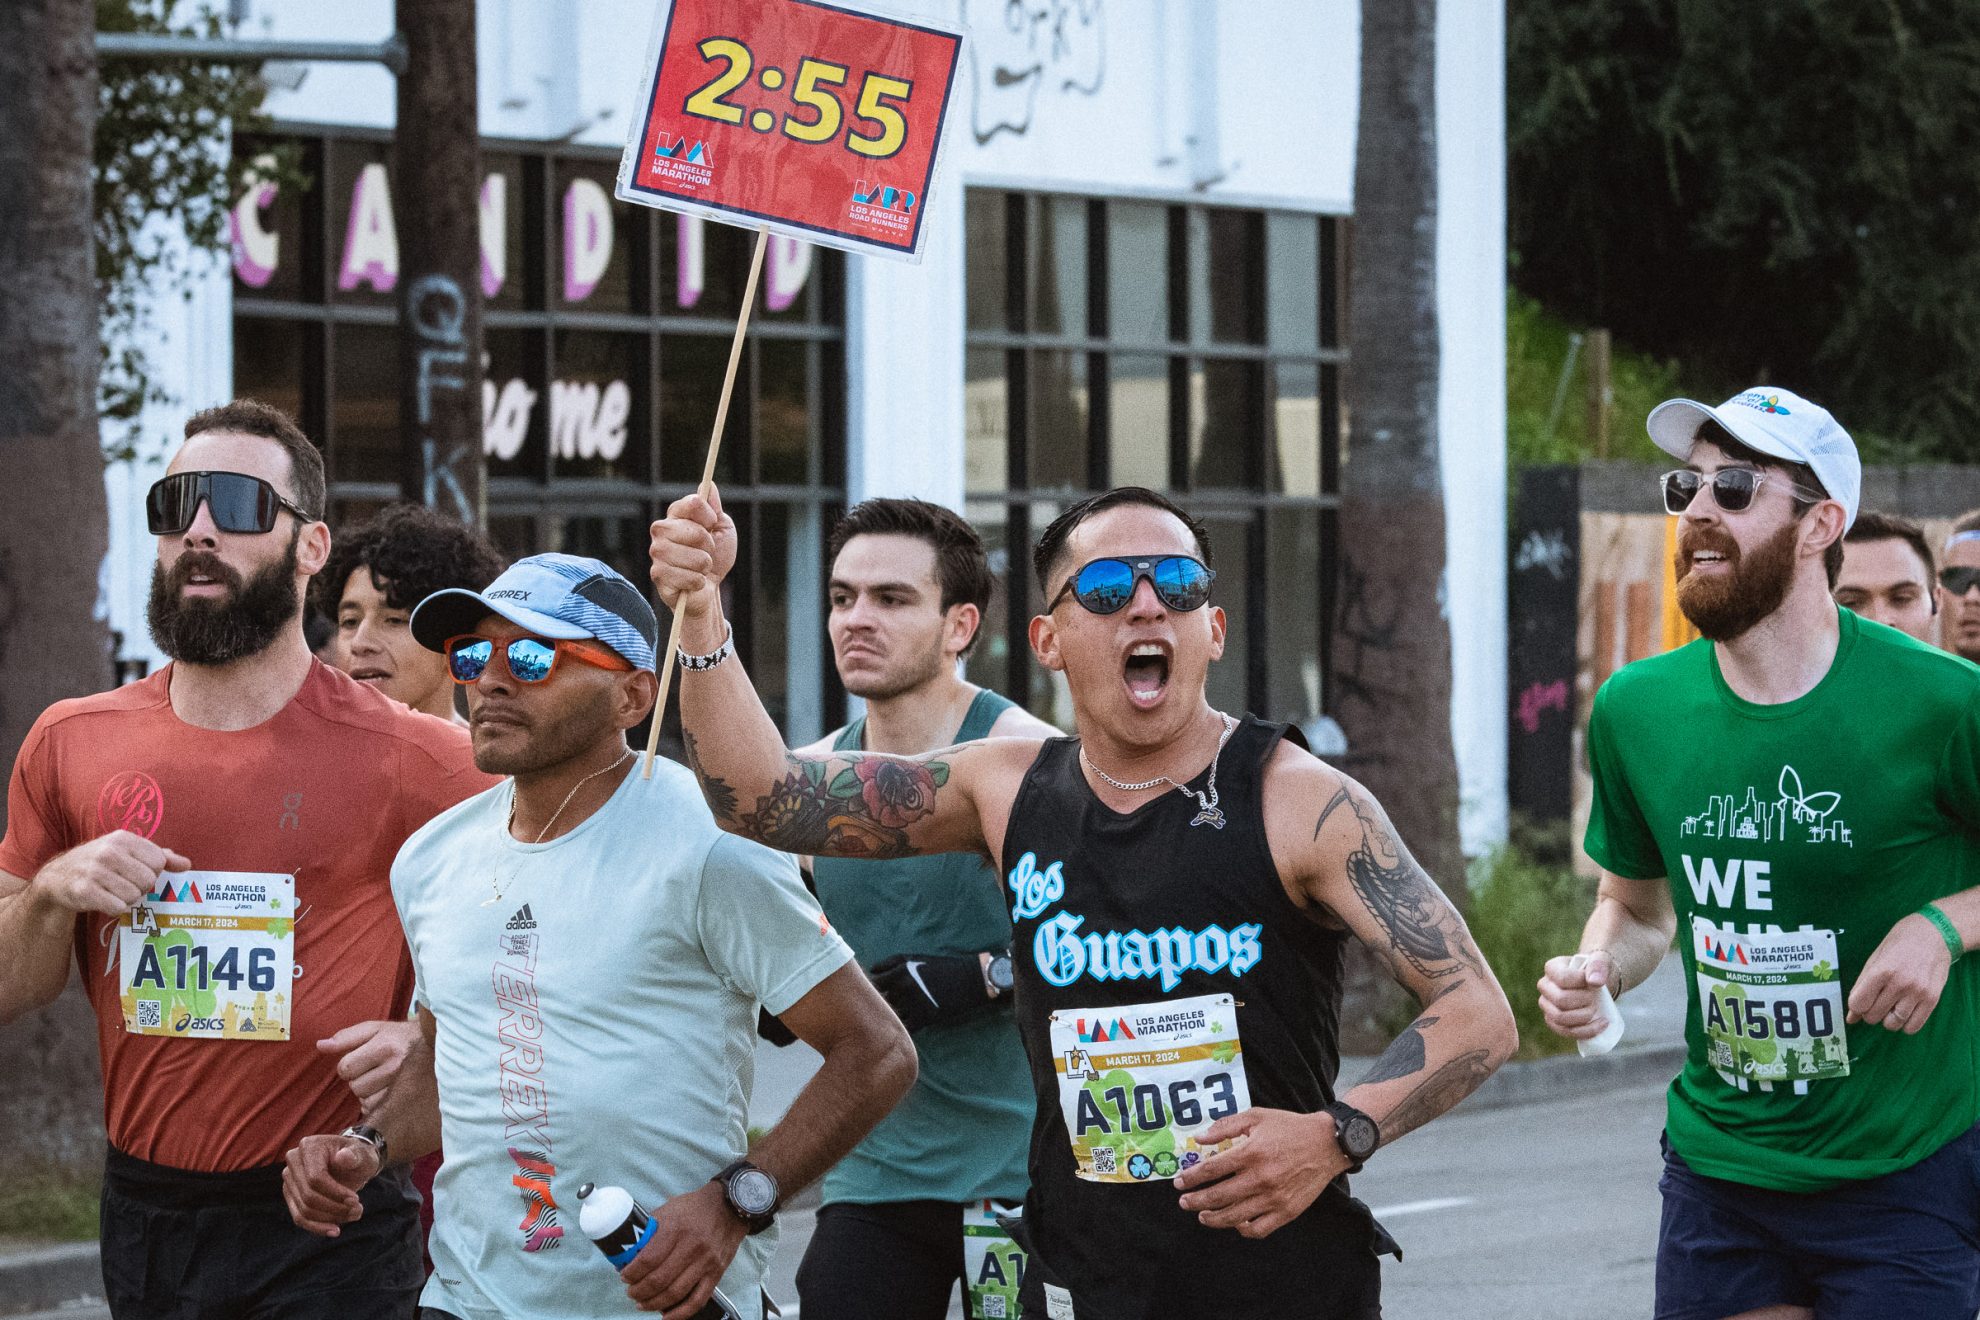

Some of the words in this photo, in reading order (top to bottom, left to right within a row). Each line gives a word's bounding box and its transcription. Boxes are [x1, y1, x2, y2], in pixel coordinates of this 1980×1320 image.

[683, 35, 914, 160] 2:55
[651, 165, 711, 186] MARATHON
[653, 158, 671, 168] LOS
[672, 163, 712, 178] ANGELES
[849, 211, 870, 222] ROAD
[871, 217, 908, 231] RUNNERS
[850, 204, 868, 214] LOS
[869, 209, 910, 224] ANGELES
[487, 589, 532, 601] TERREX
[206, 884, 222, 892] LOS
[225, 884, 266, 893] ANGELES
[1009, 851, 1065, 923] Los
[1681, 854, 1773, 910] WE
[205, 892, 266, 902] MARATHON
[170, 917, 202, 927] MARCH
[204, 917, 214, 928] 17,
[215, 918, 238, 928] 2024
[506, 919, 537, 930] adidas
[1033, 910, 1263, 993] Guapos
[1751, 952, 1814, 963] MARATHON
[1770, 944, 1813, 954] ANGELES
[132, 943, 276, 992] A1146
[1726, 972, 1752, 983] MARCH
[1752, 976, 1765, 985] 17,
[1766, 975, 1787, 984] 2024
[1136, 1017, 1154, 1026] LOS
[1158, 1010, 1205, 1023] ANGELES
[1707, 991, 1833, 1039] A1580
[1137, 1019, 1206, 1036] MARATHON
[492, 933, 552, 1153] TERREX
[1106, 1055, 1141, 1067] MARCH
[1143, 1055, 1155, 1065] 17,
[1156, 1052, 1181, 1063] 2024
[1076, 1072, 1238, 1136] A1063
